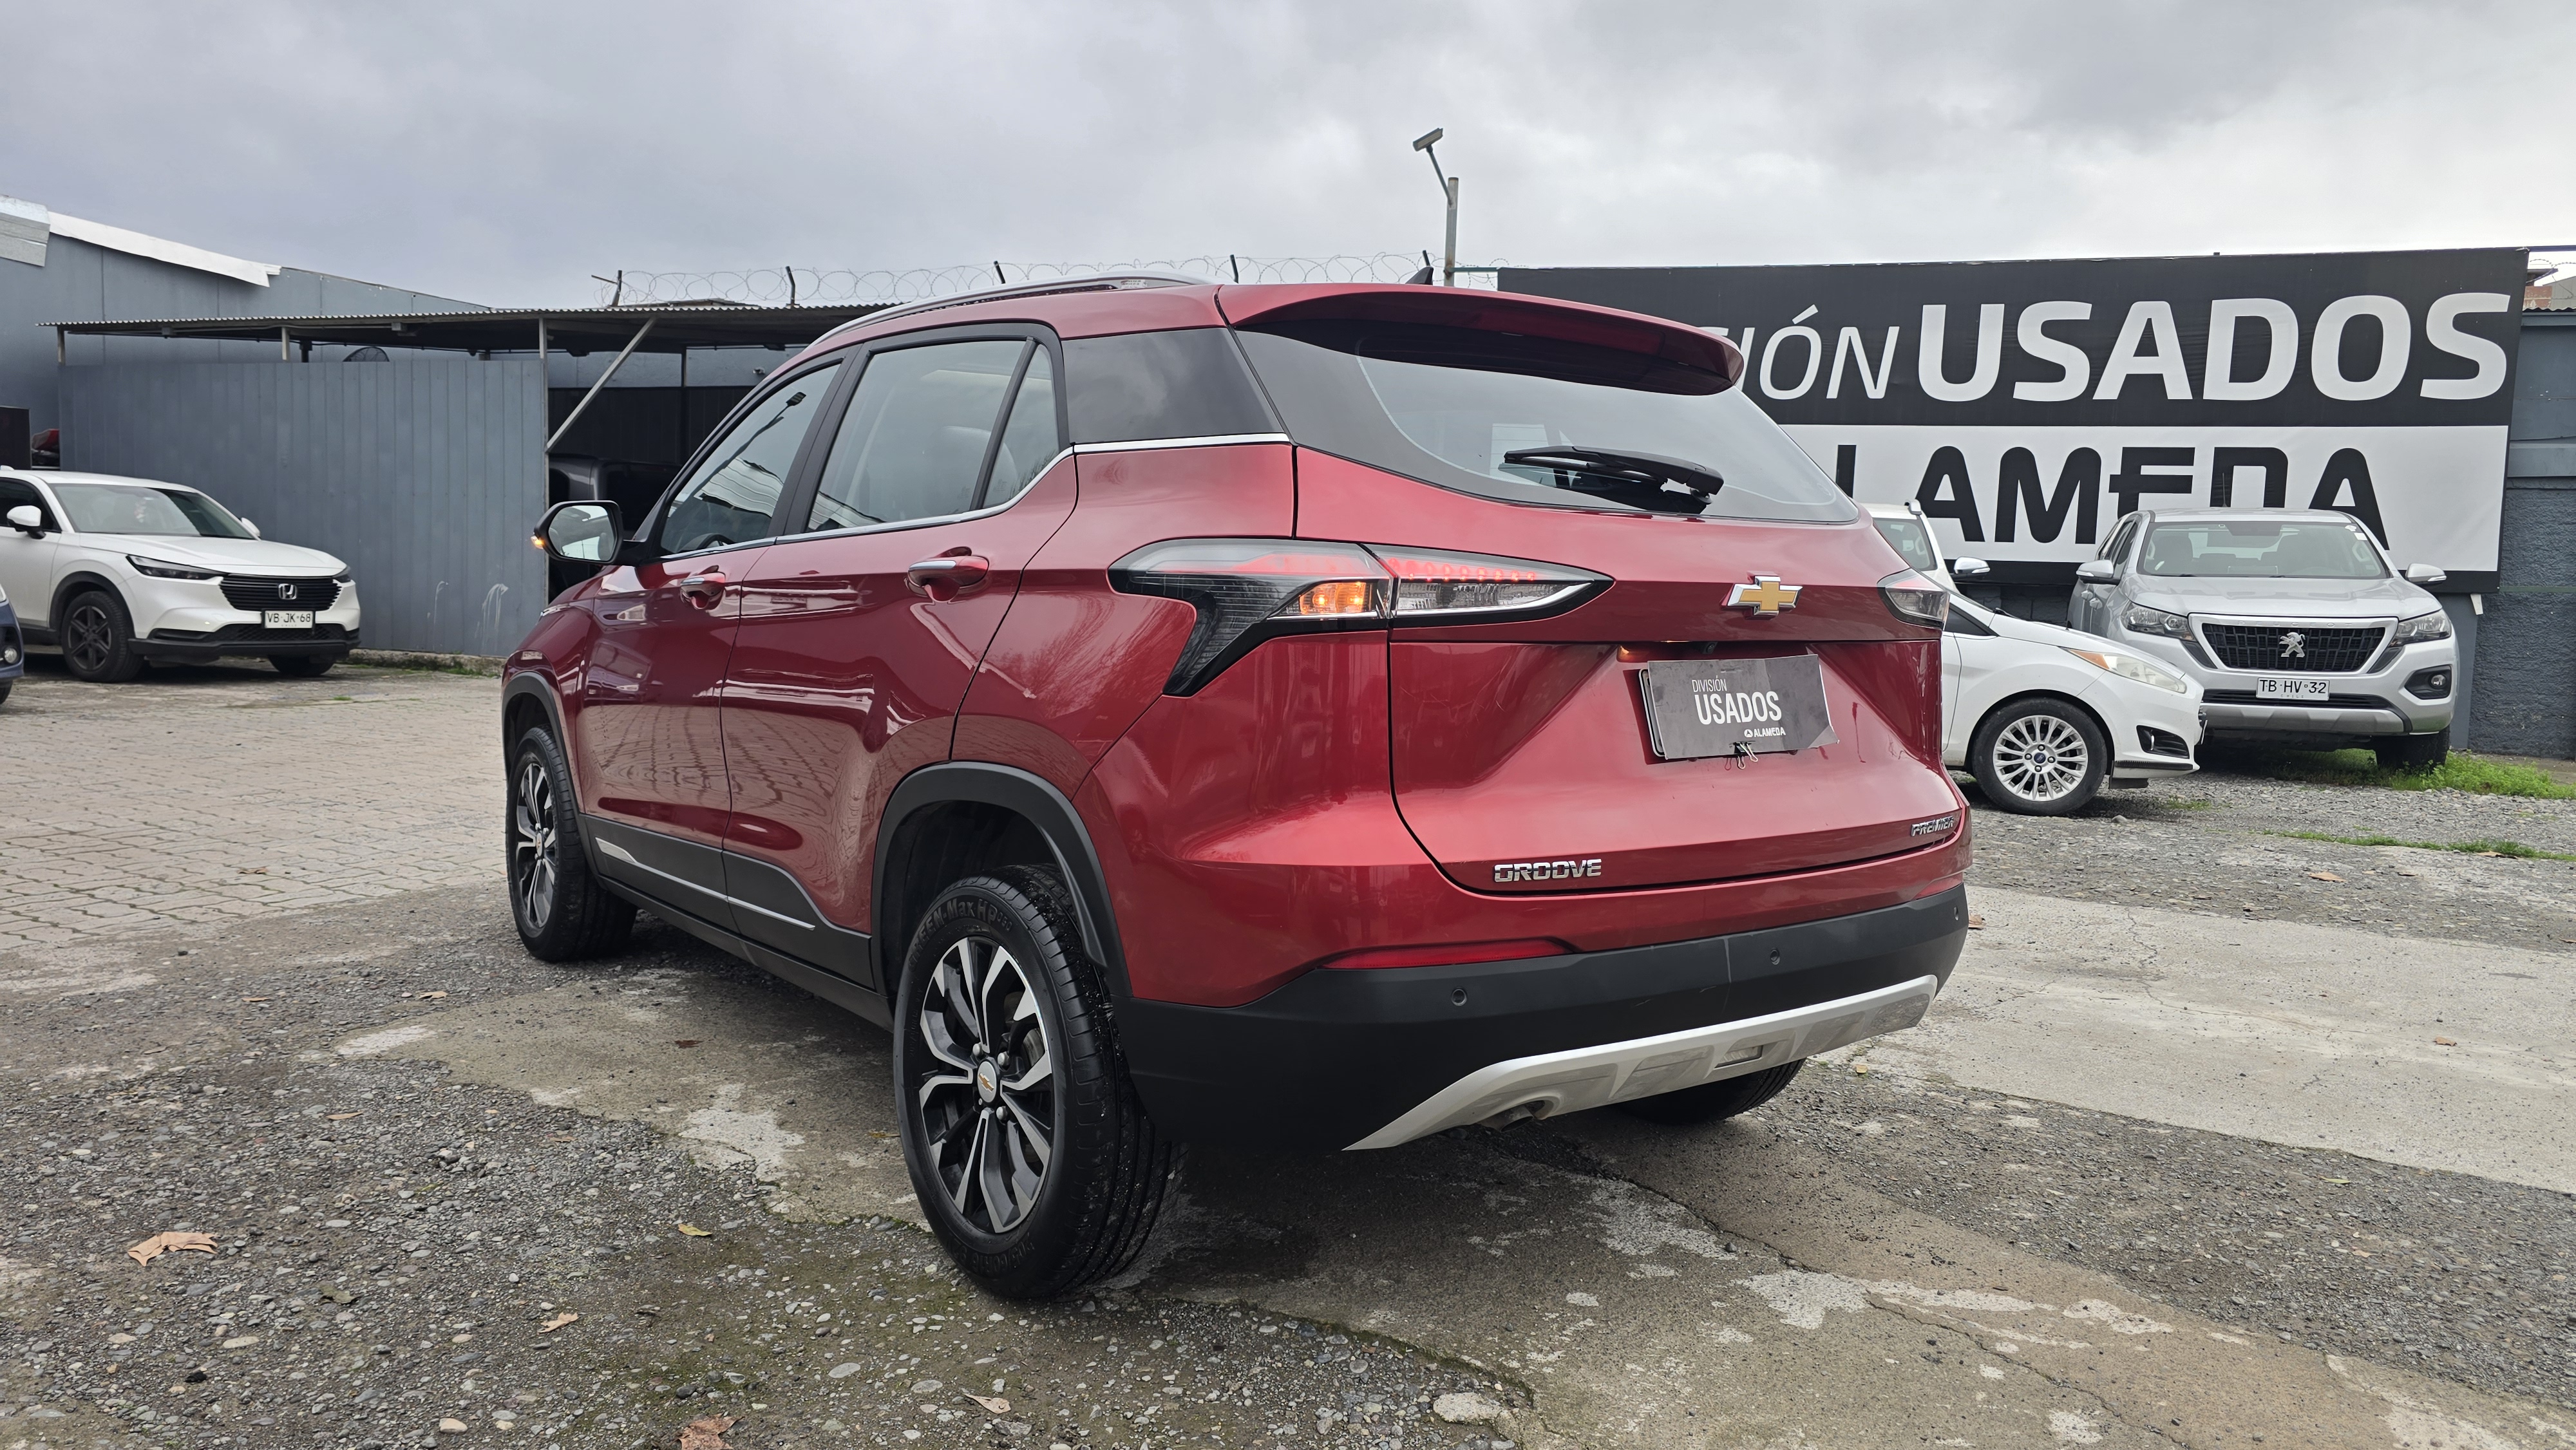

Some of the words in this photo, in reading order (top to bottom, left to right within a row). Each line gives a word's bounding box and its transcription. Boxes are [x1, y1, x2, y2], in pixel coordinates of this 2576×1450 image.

[1696, 304, 1900, 400] IÓN
[1918, 292, 2511, 402] USADOS
[1692, 676, 1727, 692] DIVISIÓN
[1694, 692, 1782, 725] USADOS
[1754, 728, 1786, 738] ALAMEDA
[1911, 816, 1953, 836] PREMIER
[1494, 858, 1602, 883] GROOVE
